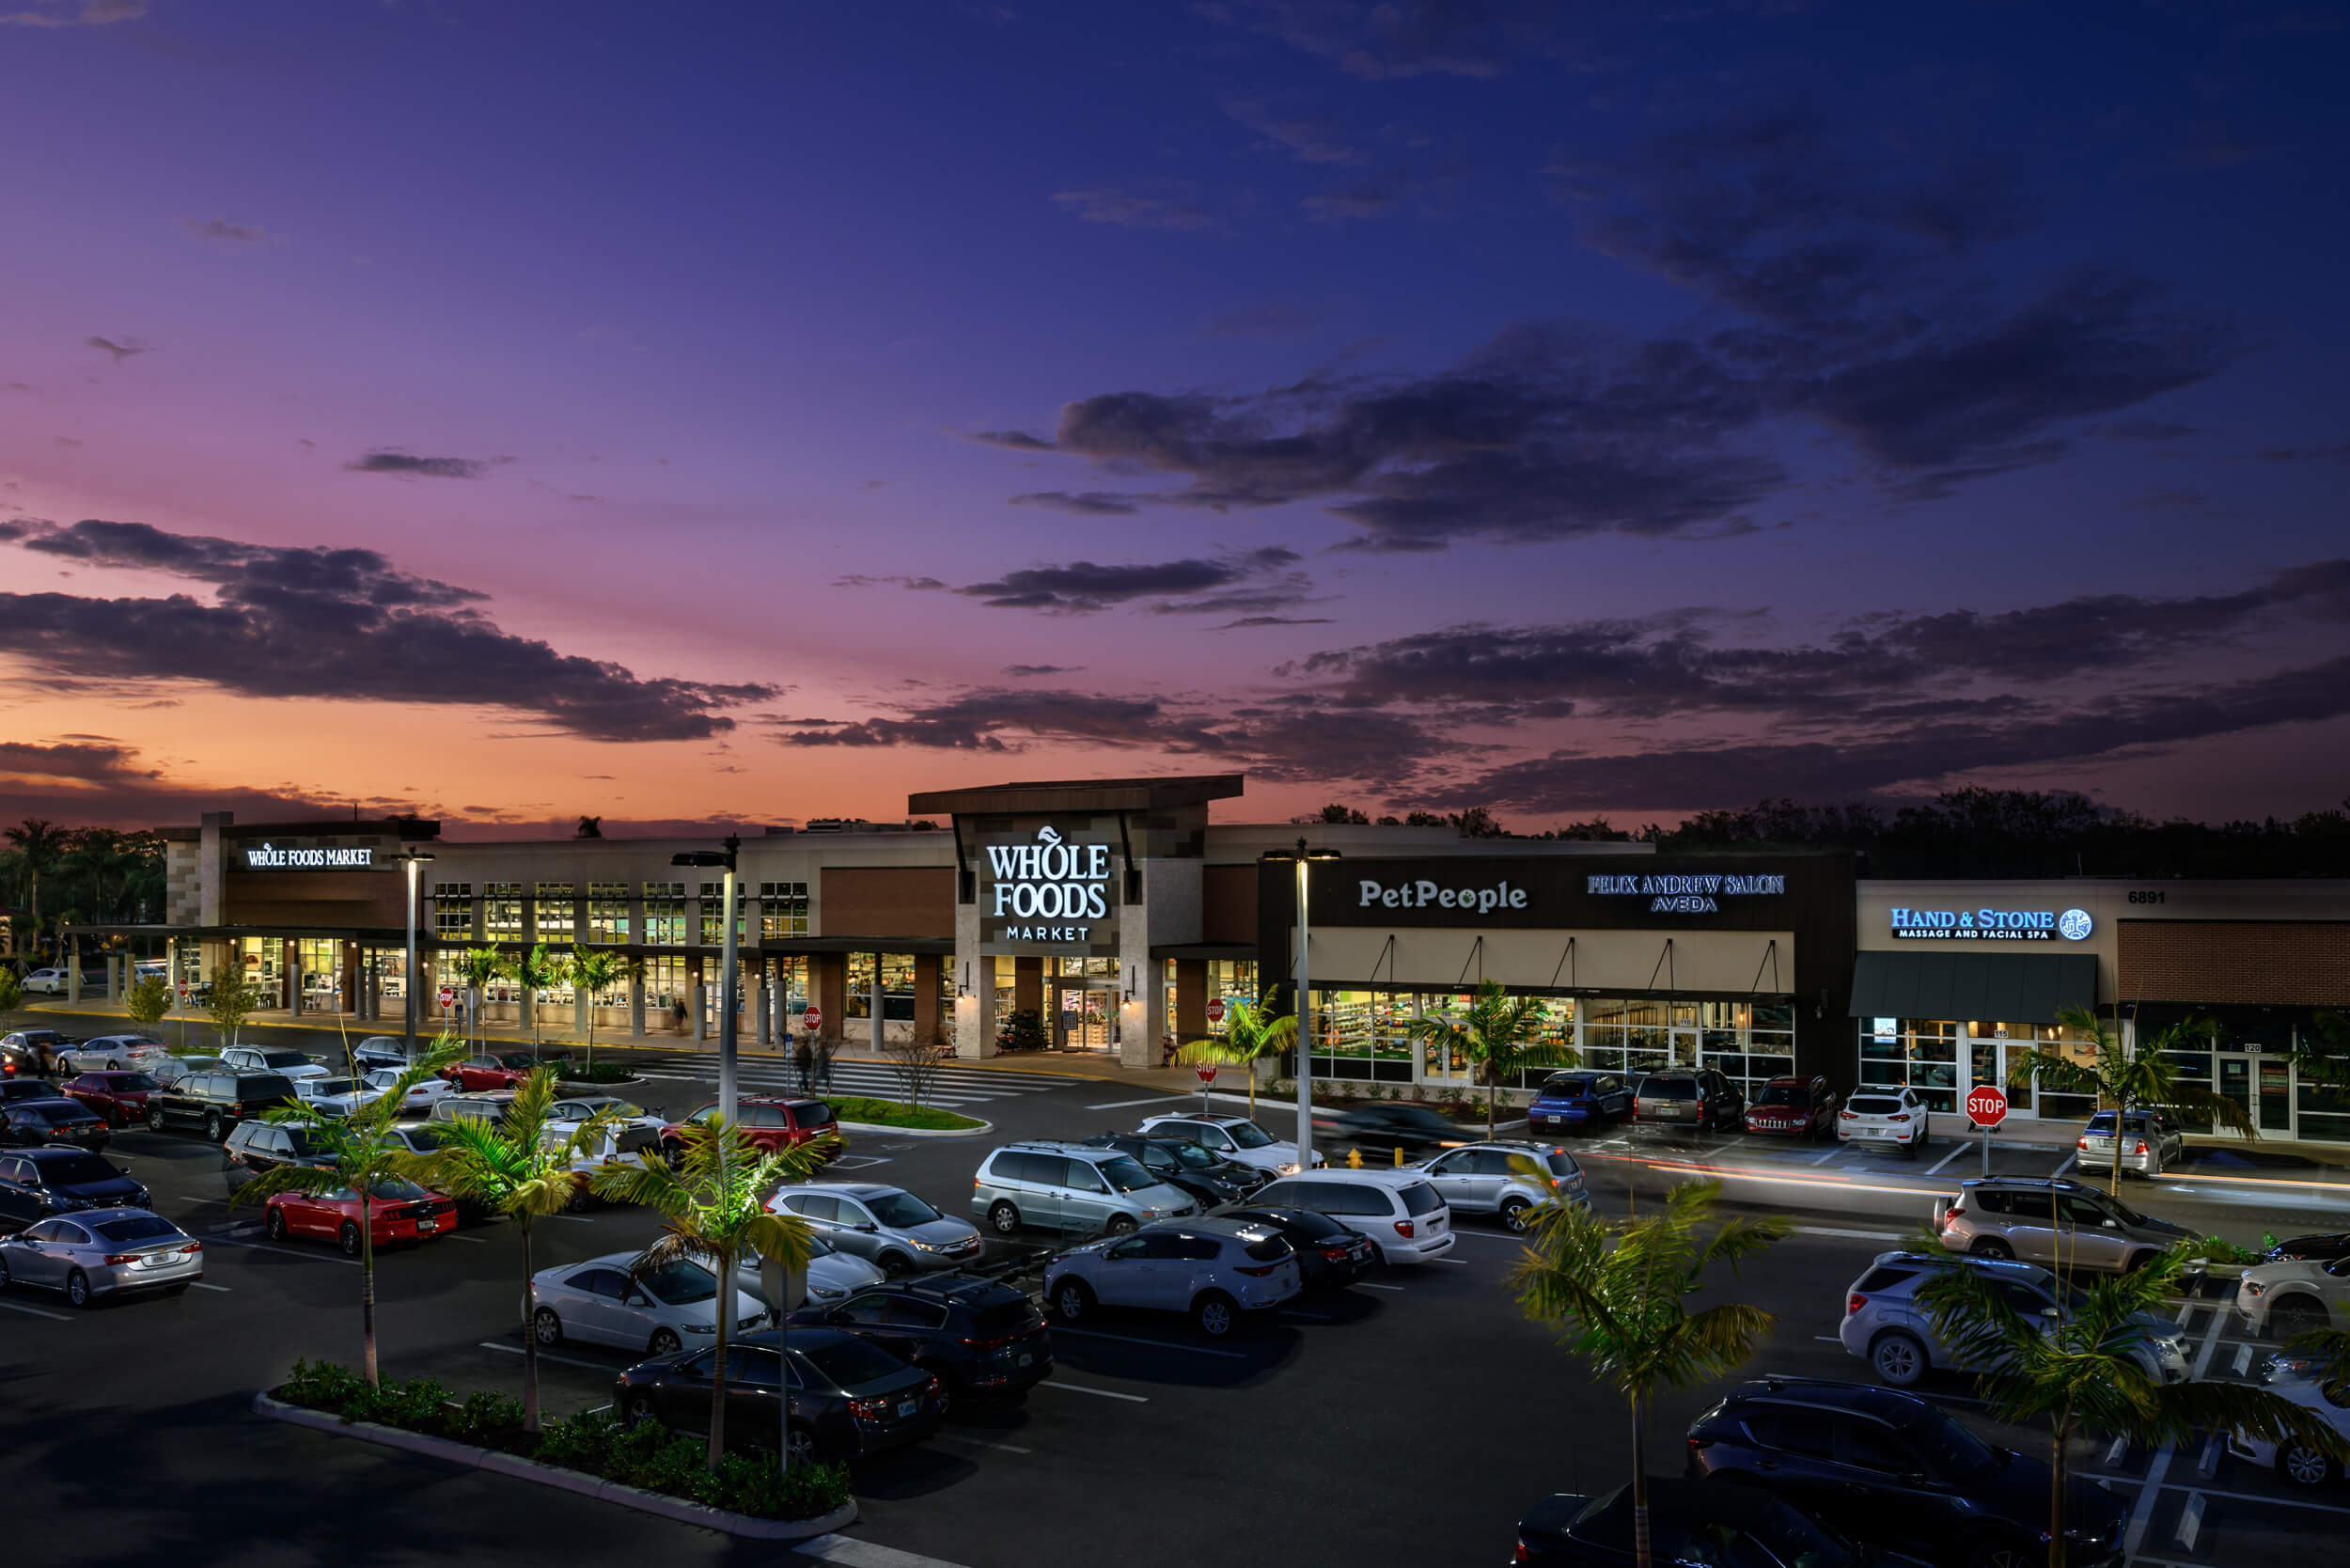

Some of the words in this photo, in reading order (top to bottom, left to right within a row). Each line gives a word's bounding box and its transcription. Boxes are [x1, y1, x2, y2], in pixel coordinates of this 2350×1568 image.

[247, 848, 286, 866] WHOLE
[288, 849, 324, 866] FOODS
[325, 848, 372, 865] MARKET
[985, 843, 1109, 880] WHOLE
[1587, 875, 1638, 894] FELIX
[1642, 875, 1722, 894] ANDREW
[1724, 875, 1786, 894] SALON
[994, 882, 1106, 918] FOODS
[1359, 880, 1528, 914] PetPeople
[1651, 896, 1717, 912] AVEDA
[2128, 890, 2165, 903] 6891
[1890, 908, 1956, 928] HAND
[1959, 911, 1974, 928] &
[1978, 908, 2056, 928] STONE
[1007, 925, 1088, 941] MARKET
[1899, 929, 1951, 938] MASSAGE
[1955, 930, 1978, 938] AND
[1982, 930, 2023, 939] FACIAL
[2027, 931, 2048, 939] SPA
[805, 1013, 821, 1024] STOP
[1207, 1006, 1223, 1015] STOP
[1968, 1097, 2004, 1114] STOP
